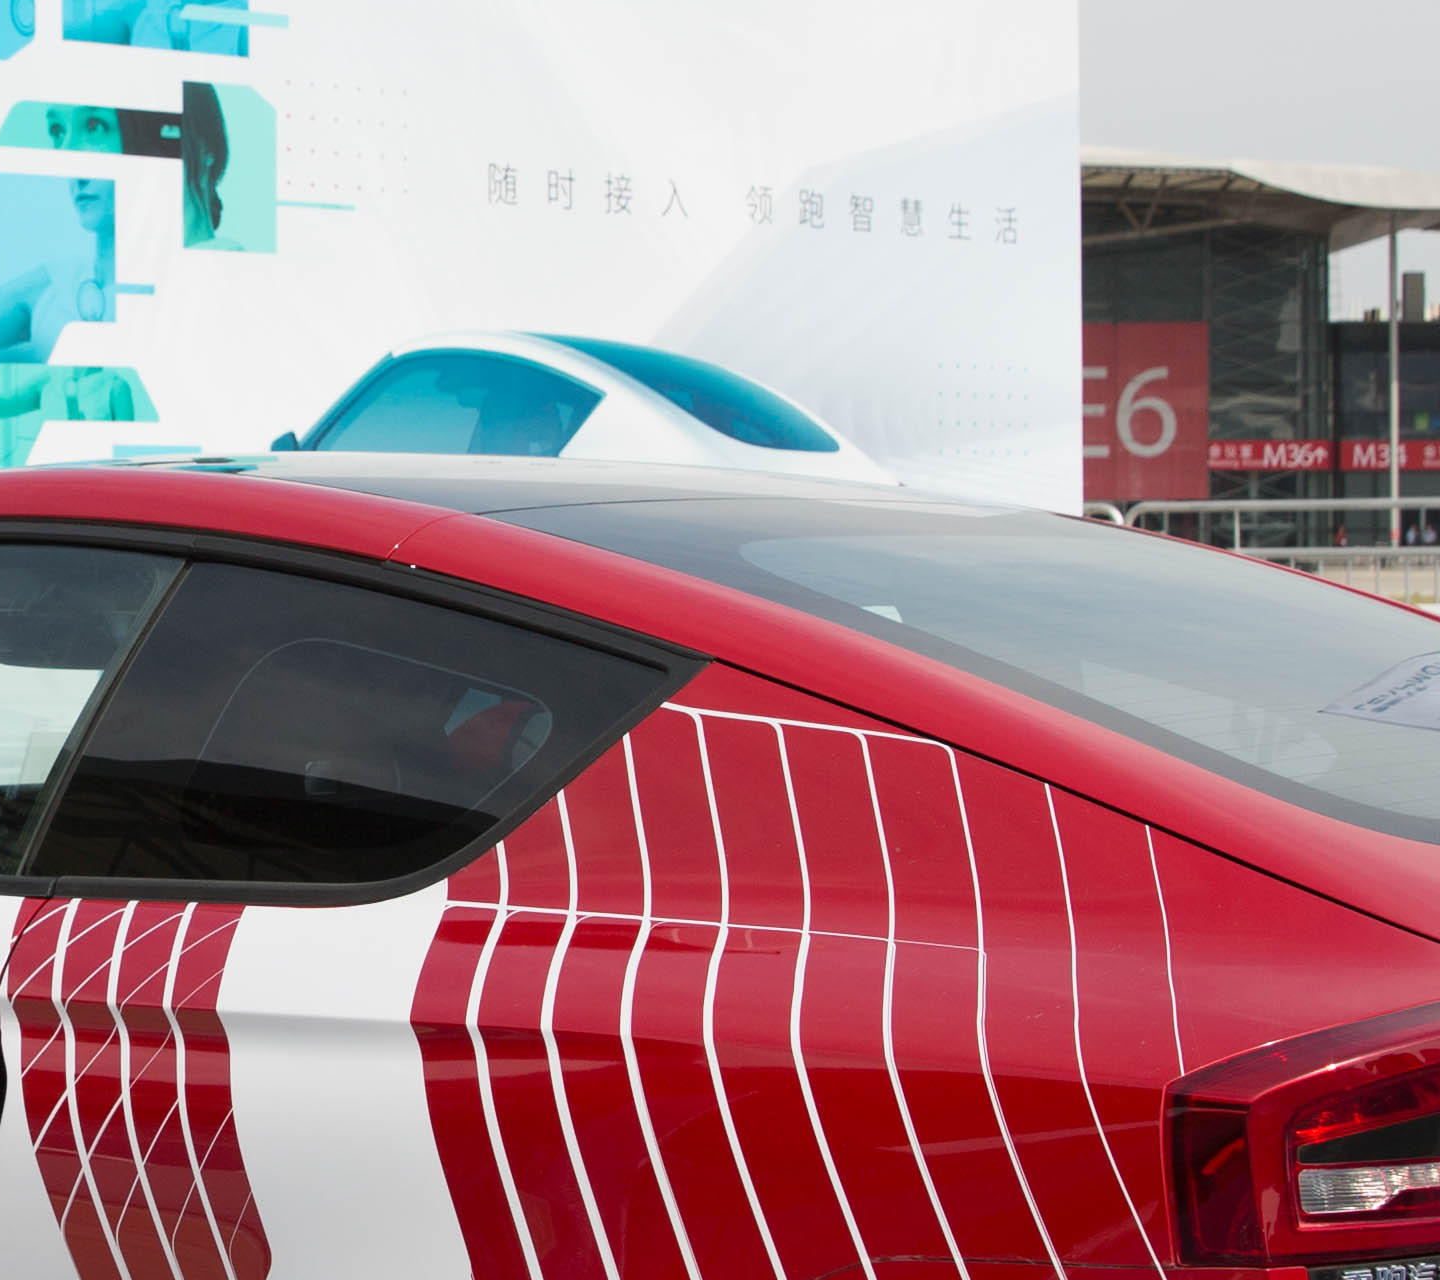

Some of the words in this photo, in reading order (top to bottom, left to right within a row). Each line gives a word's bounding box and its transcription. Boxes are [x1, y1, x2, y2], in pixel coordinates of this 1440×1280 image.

[487, 161, 689, 220] 随时接入
[745, 183, 1020, 246] 领跑智慧生活
[1262, 443, 1315, 469] M36
